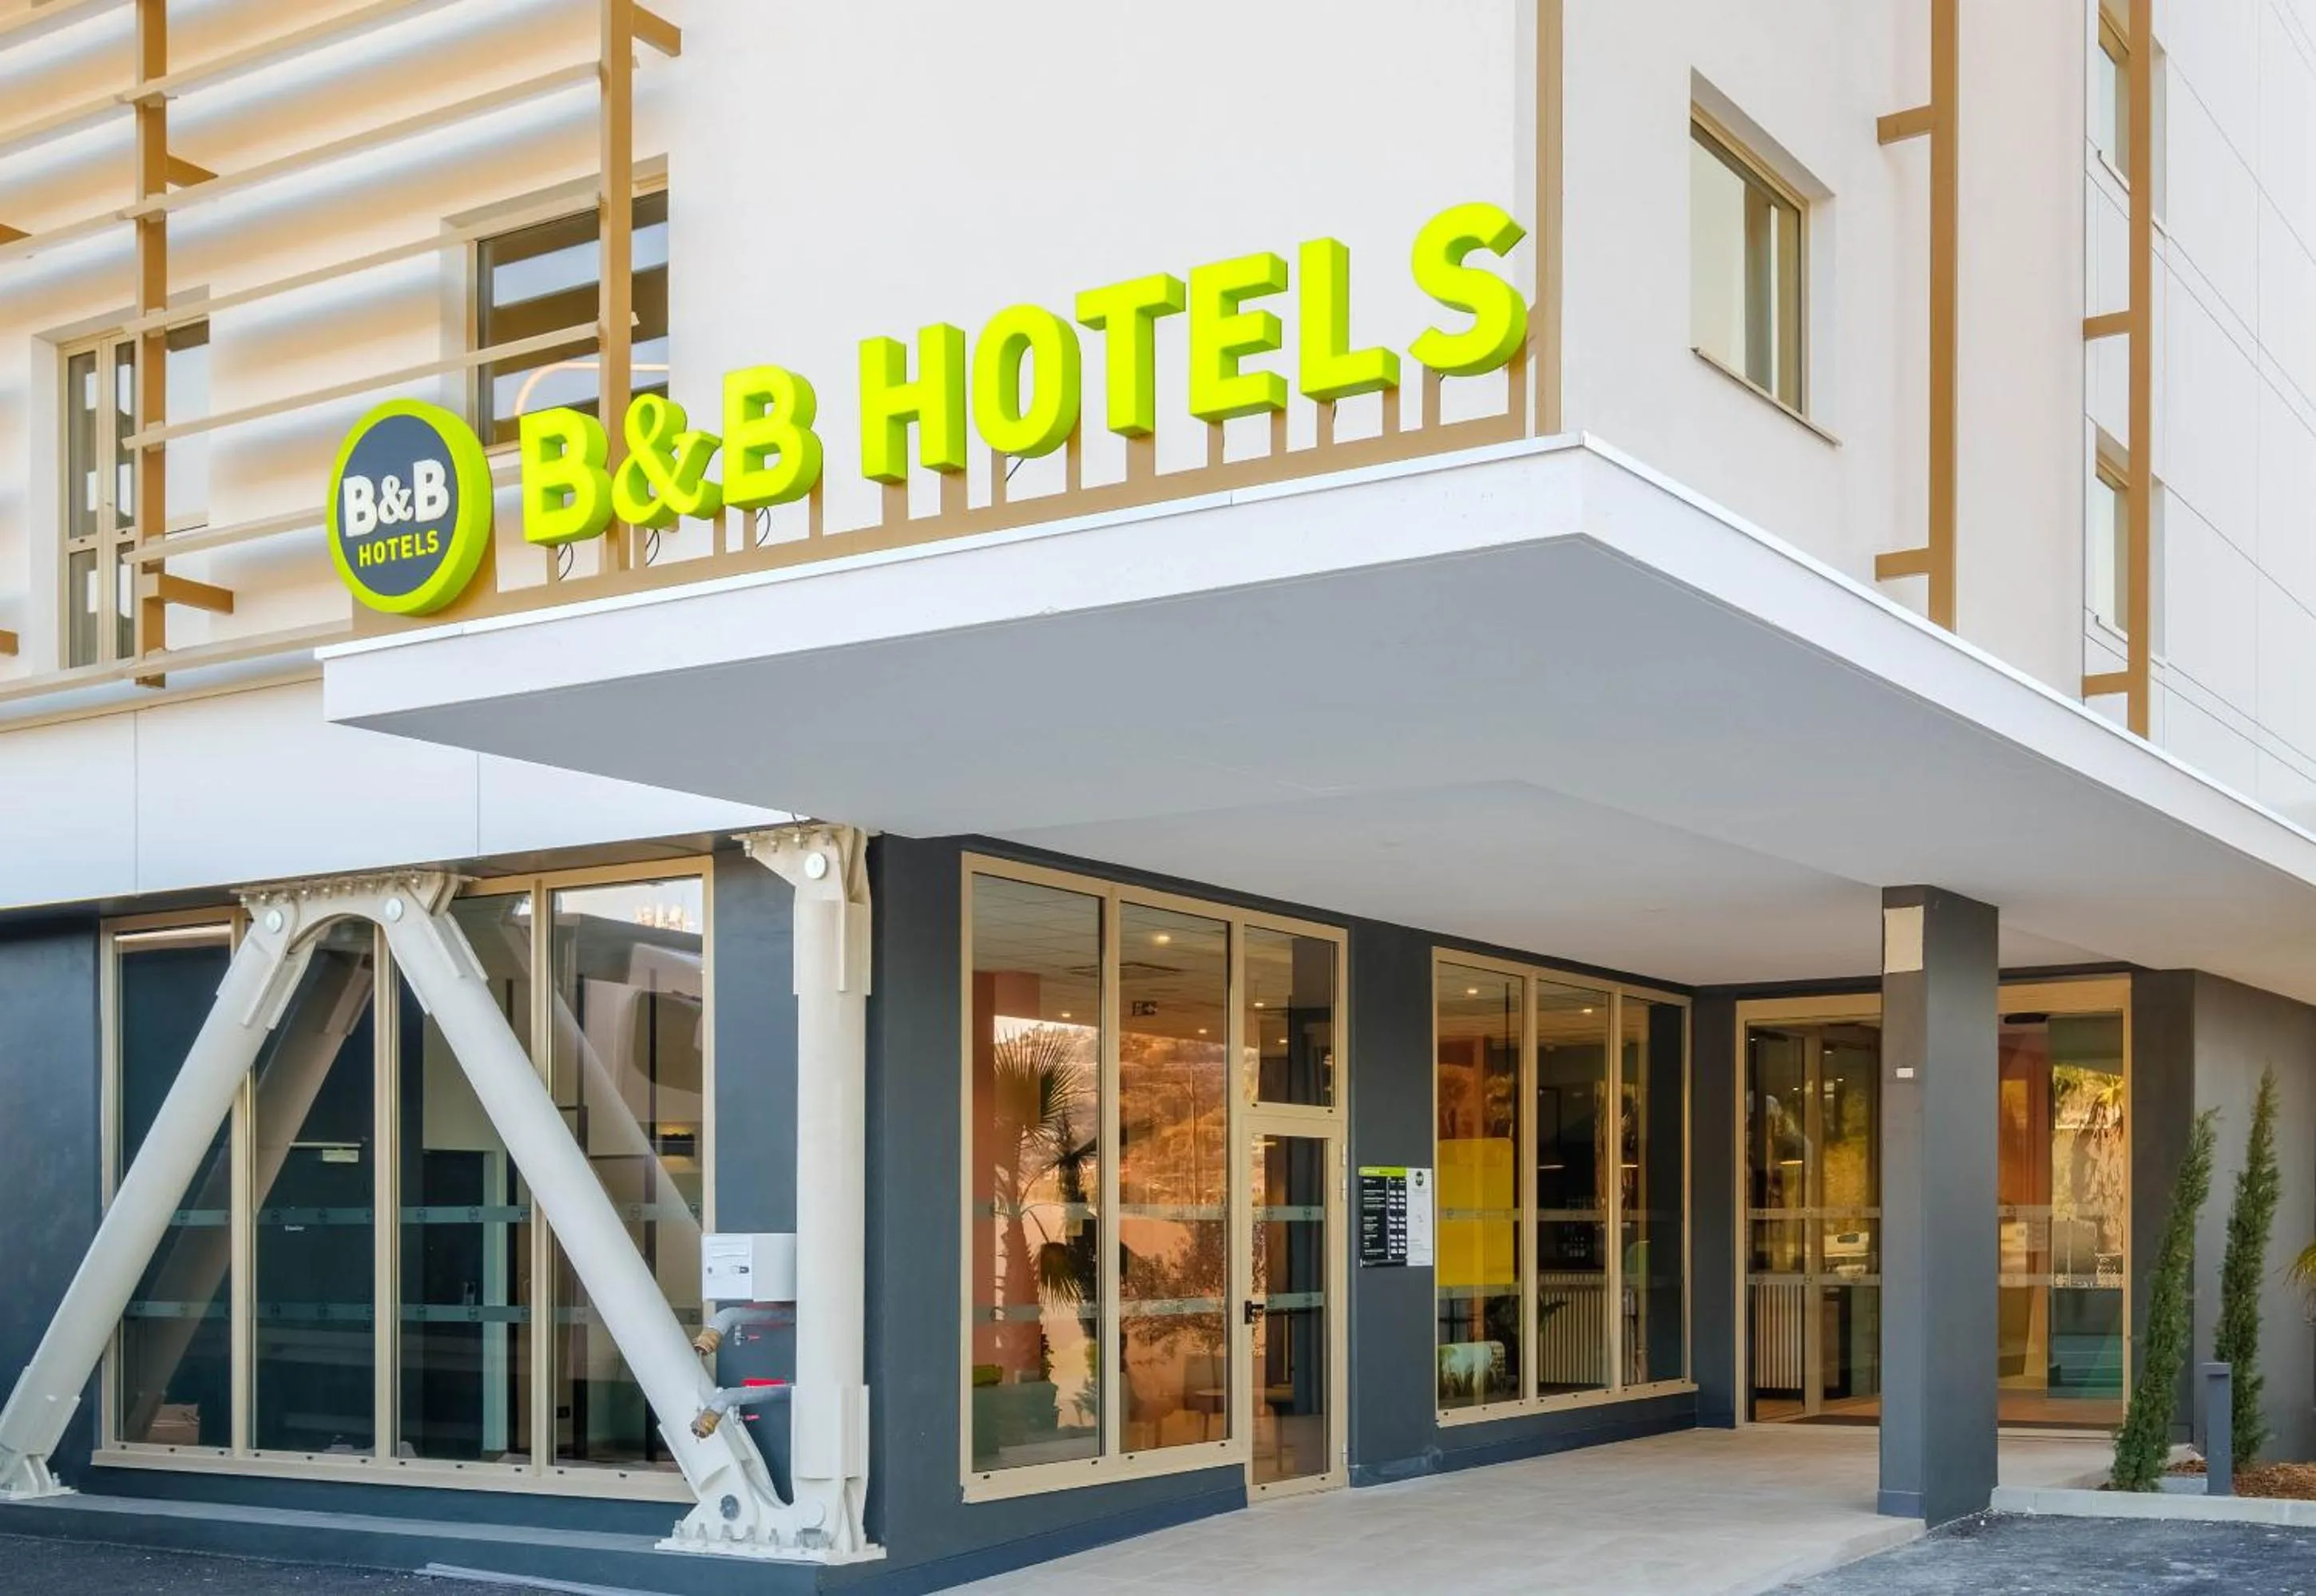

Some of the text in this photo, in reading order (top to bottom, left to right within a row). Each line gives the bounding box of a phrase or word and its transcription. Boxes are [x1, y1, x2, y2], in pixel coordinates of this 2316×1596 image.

[520, 201, 1529, 545] B&B HOTELS
[343, 458, 450, 537] B&B
[359, 529, 439, 568] HOTELS
